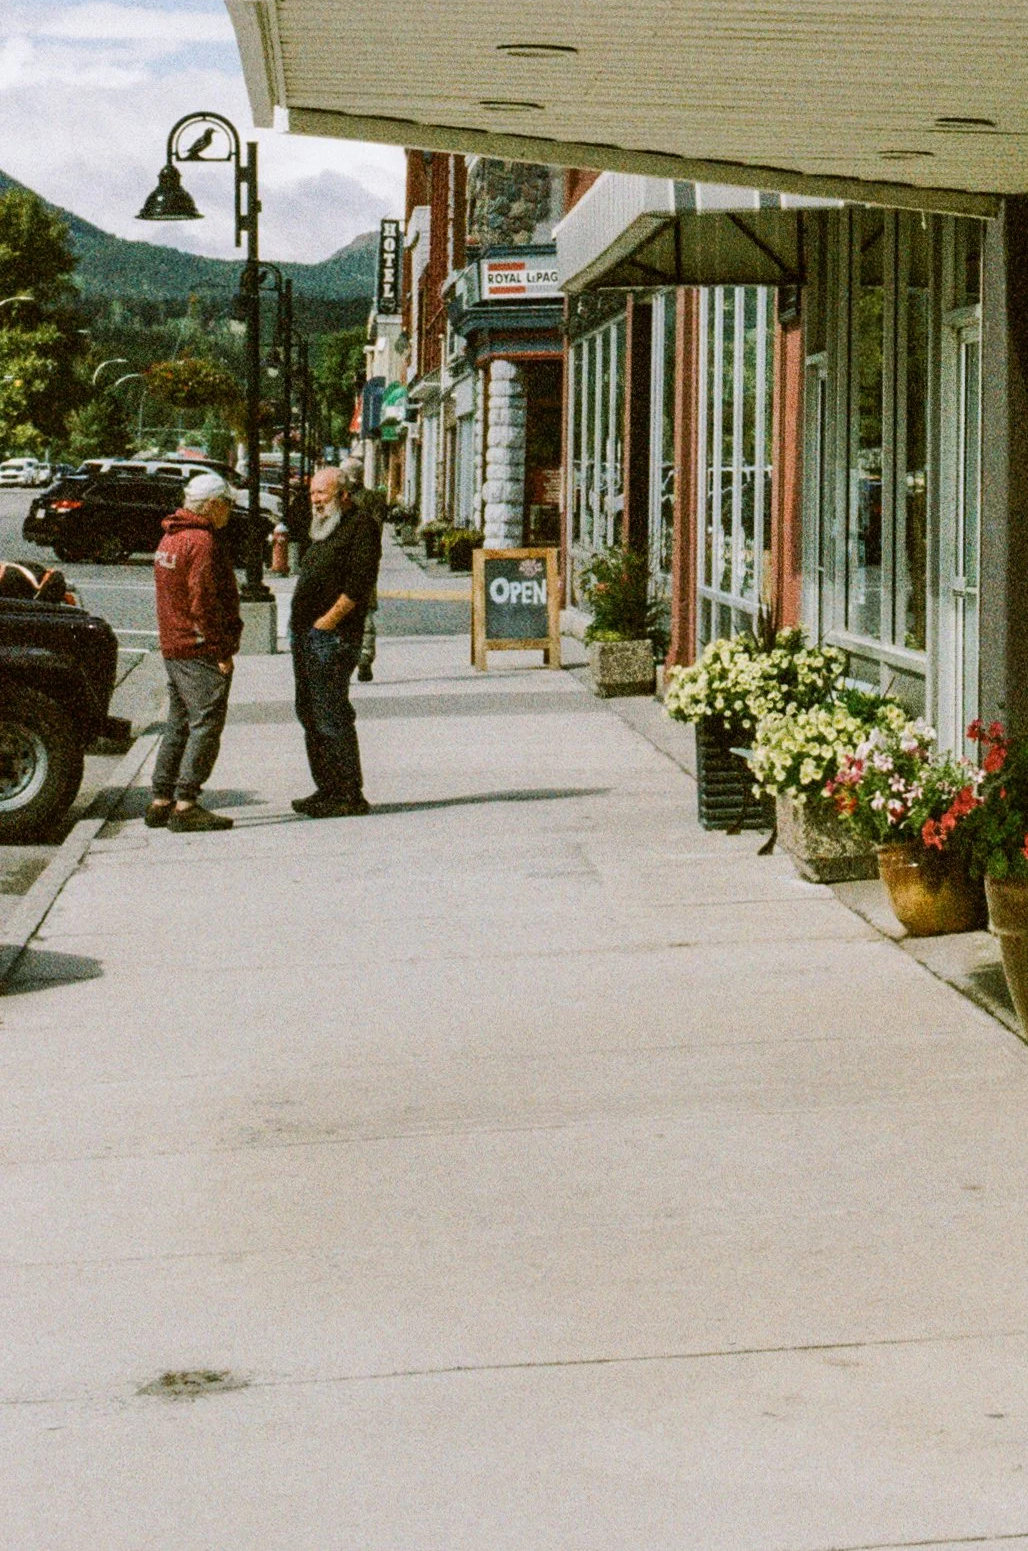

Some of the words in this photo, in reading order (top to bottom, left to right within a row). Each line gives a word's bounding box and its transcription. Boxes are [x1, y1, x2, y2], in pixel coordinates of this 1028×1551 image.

[383, 223, 397, 298] HOTEL
[488, 273, 522, 284] ROYAL
[490, 578, 547, 604] OPEN
